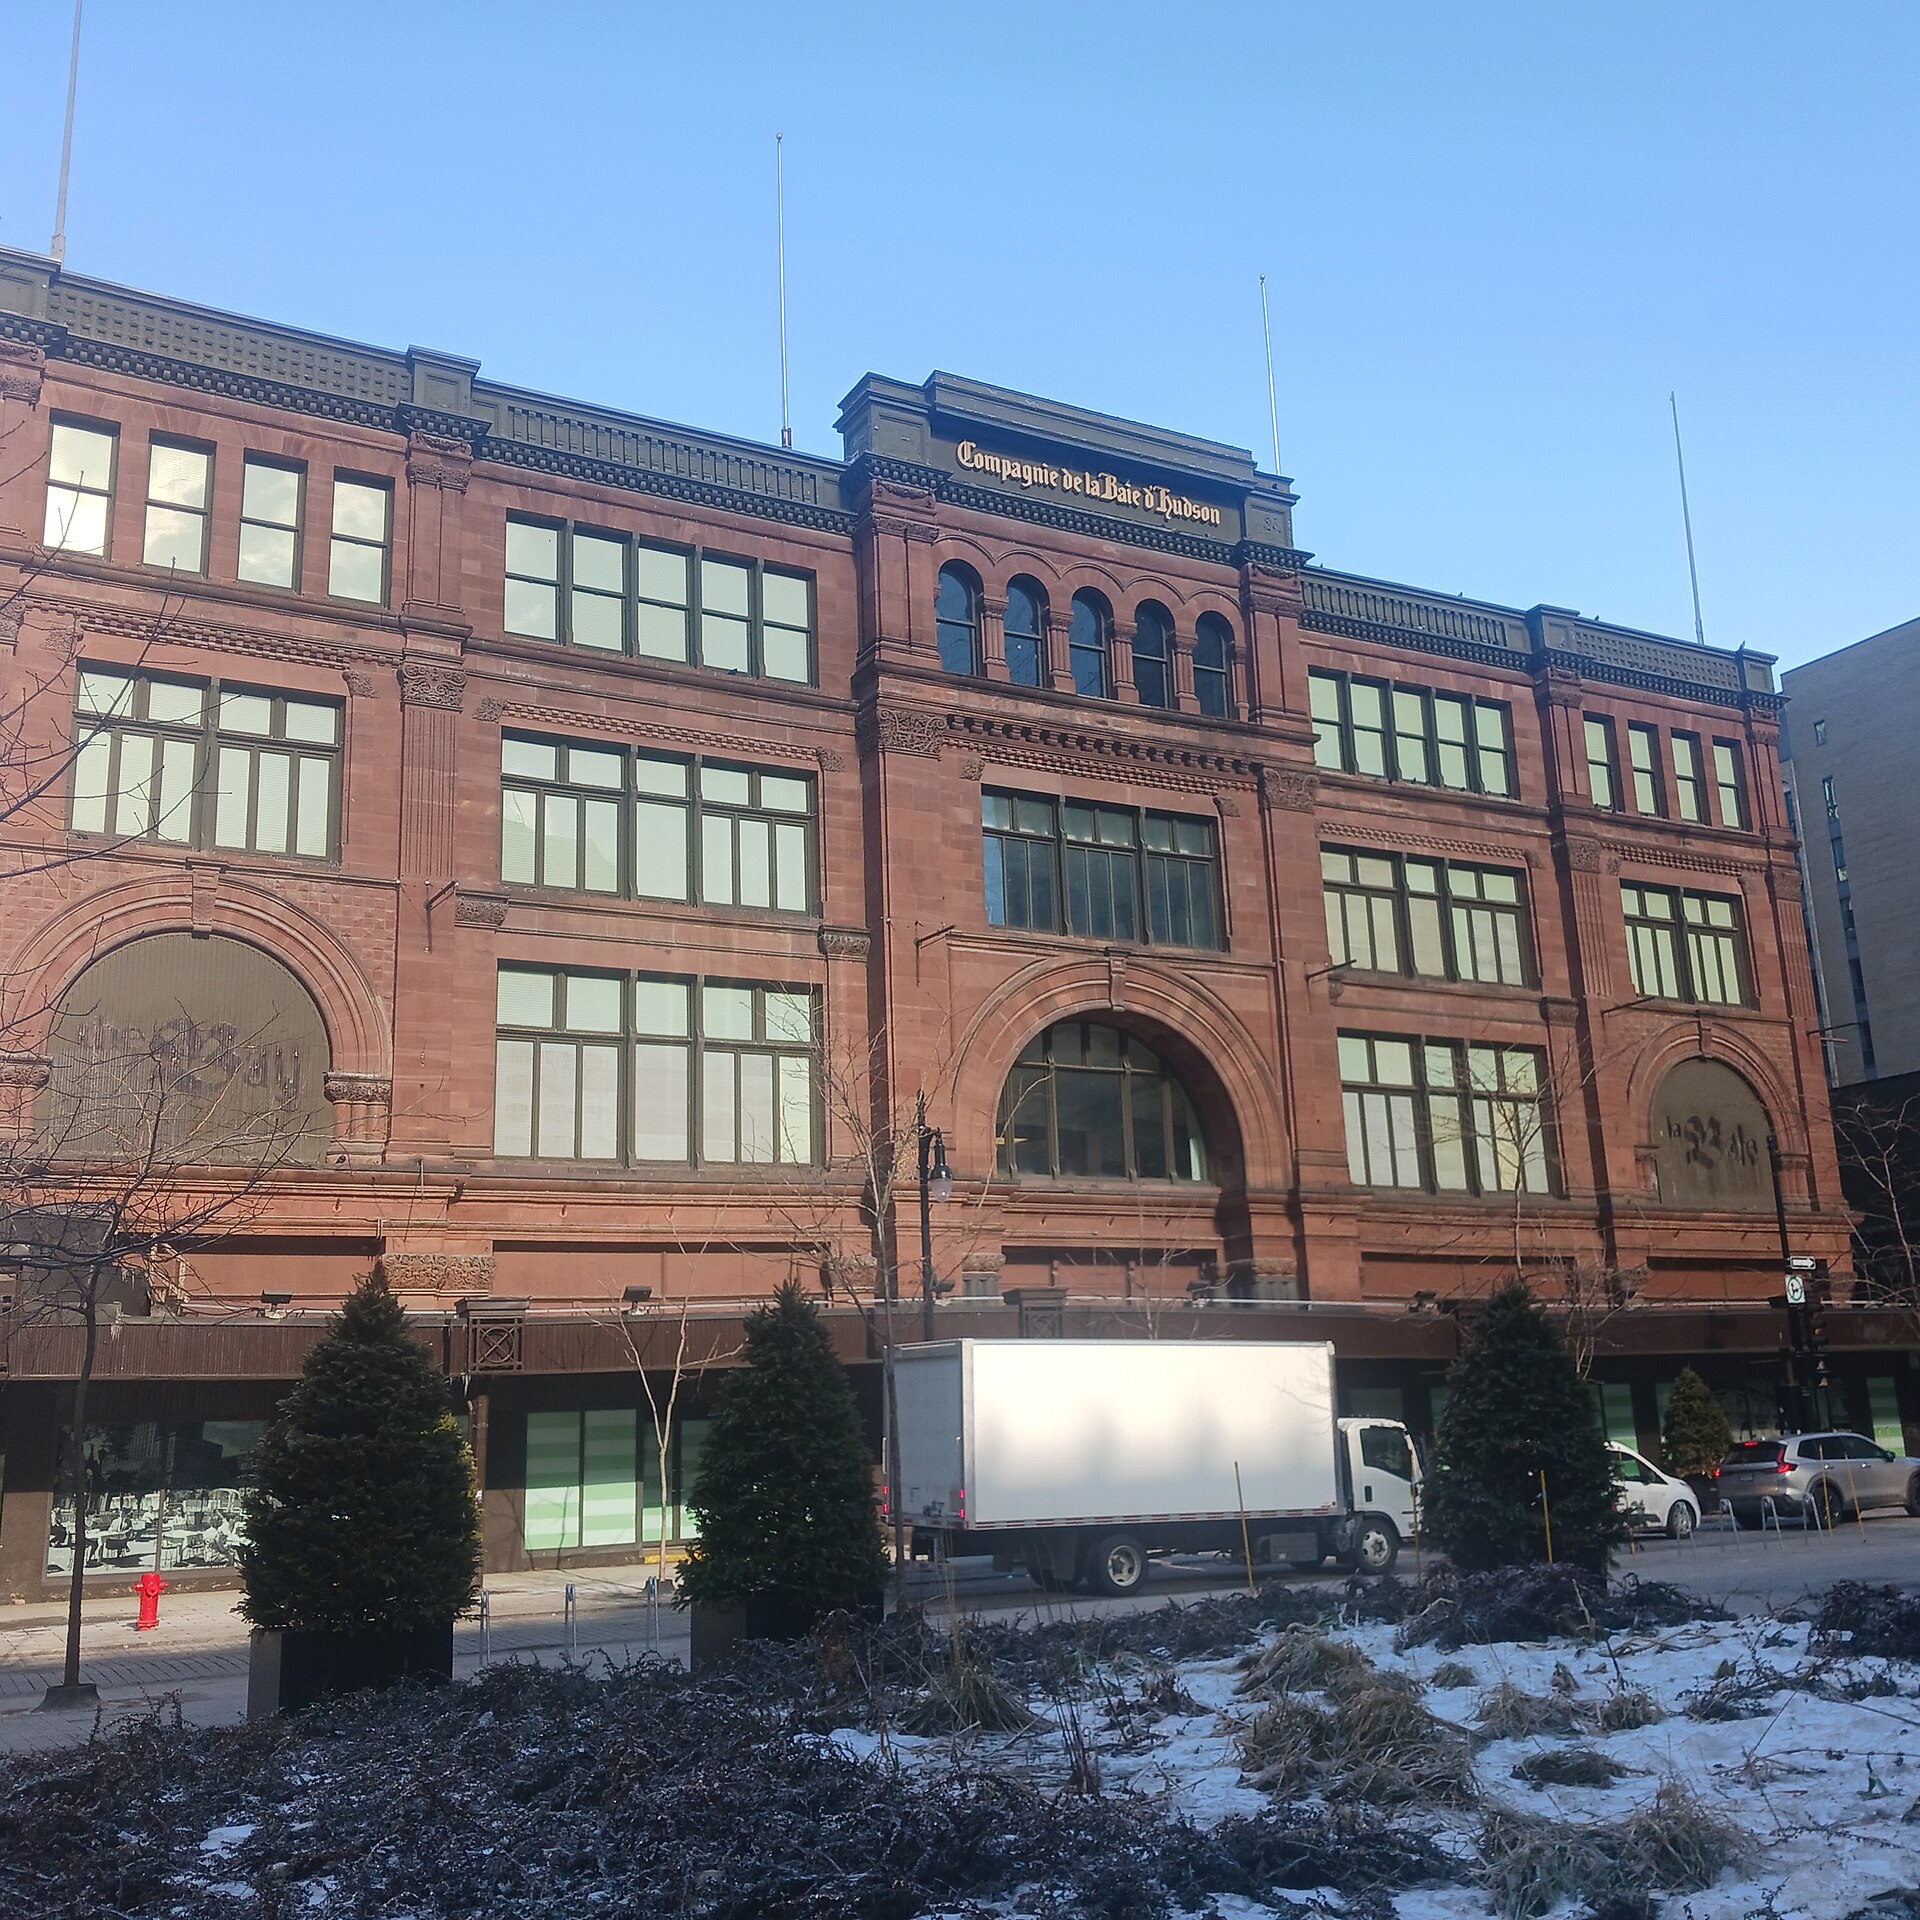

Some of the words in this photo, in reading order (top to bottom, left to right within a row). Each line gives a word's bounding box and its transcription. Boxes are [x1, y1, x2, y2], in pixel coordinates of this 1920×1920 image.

[956, 440, 1059, 488] Compagnie
[1061, 468, 1083, 492] de
[1085, 472, 1101, 498] la
[1098, 472, 1140, 507] Baie
[1144, 485, 1221, 526] d'Hudson
